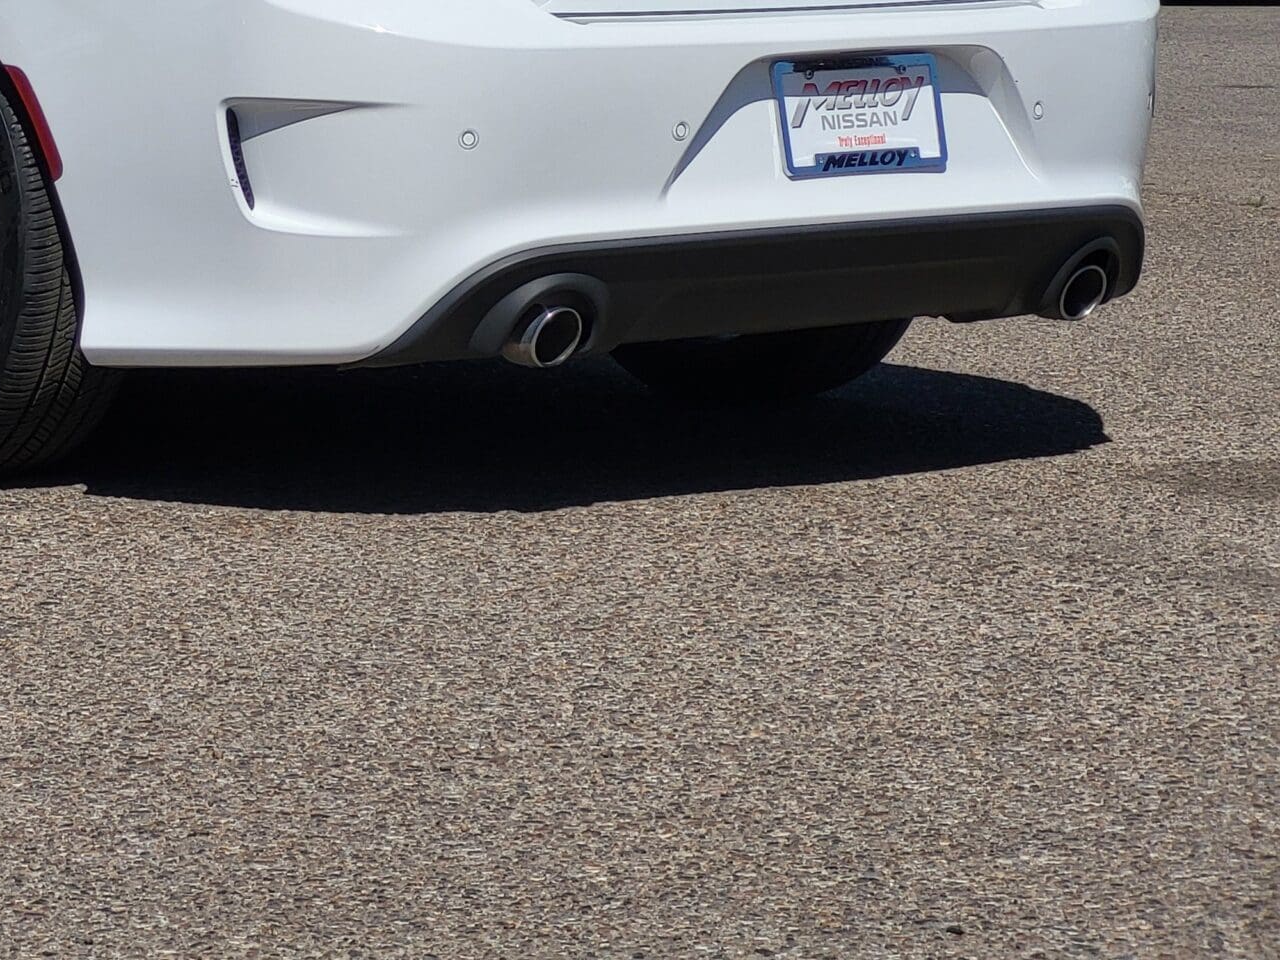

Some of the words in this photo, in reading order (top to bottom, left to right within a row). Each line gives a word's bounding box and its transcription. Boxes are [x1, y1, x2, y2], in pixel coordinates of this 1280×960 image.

[791, 75, 924, 129] MELLOY
[821, 110, 898, 131] NISSAN
[822, 149, 909, 172] MELLOY
